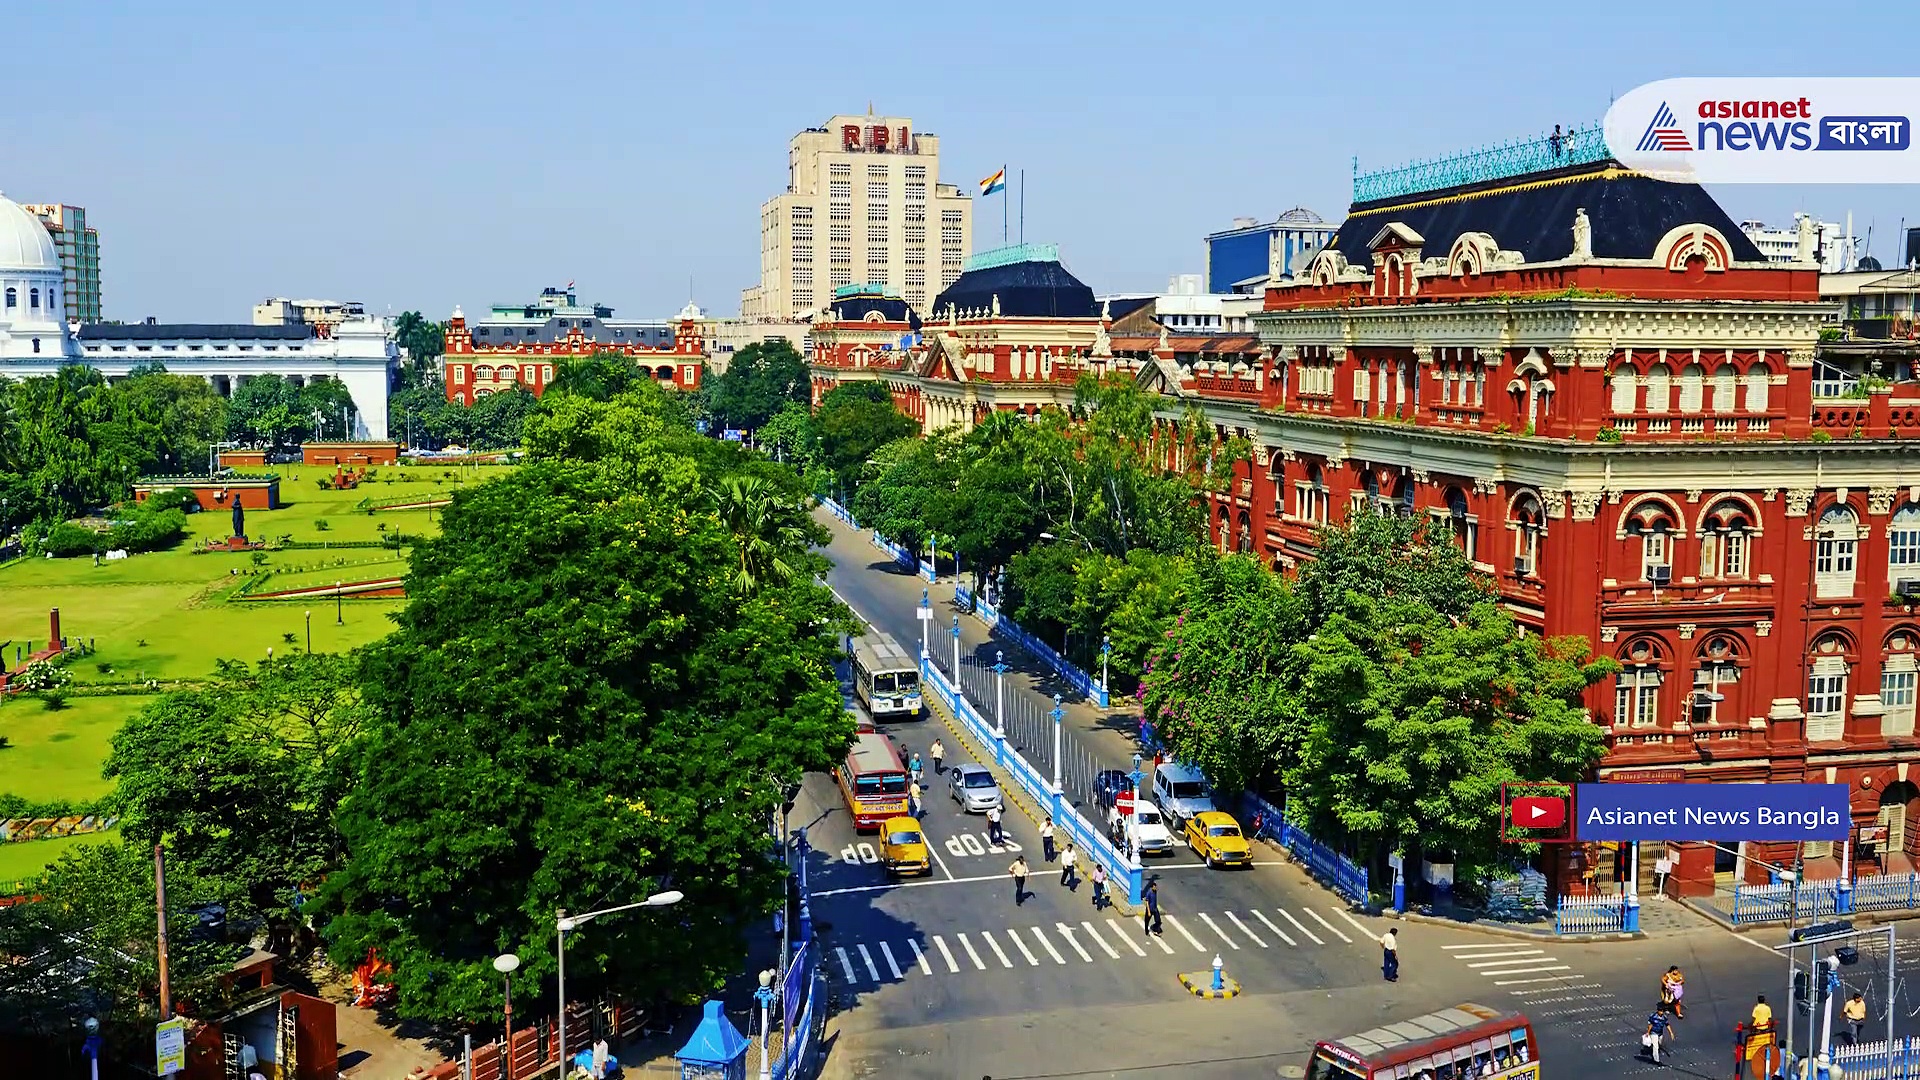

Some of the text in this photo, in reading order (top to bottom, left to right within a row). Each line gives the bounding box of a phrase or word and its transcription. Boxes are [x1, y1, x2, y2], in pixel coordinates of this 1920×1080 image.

[844, 125, 908, 148] RBI
[840, 842, 879, 865] OP
[945, 831, 1023, 857] STOP
